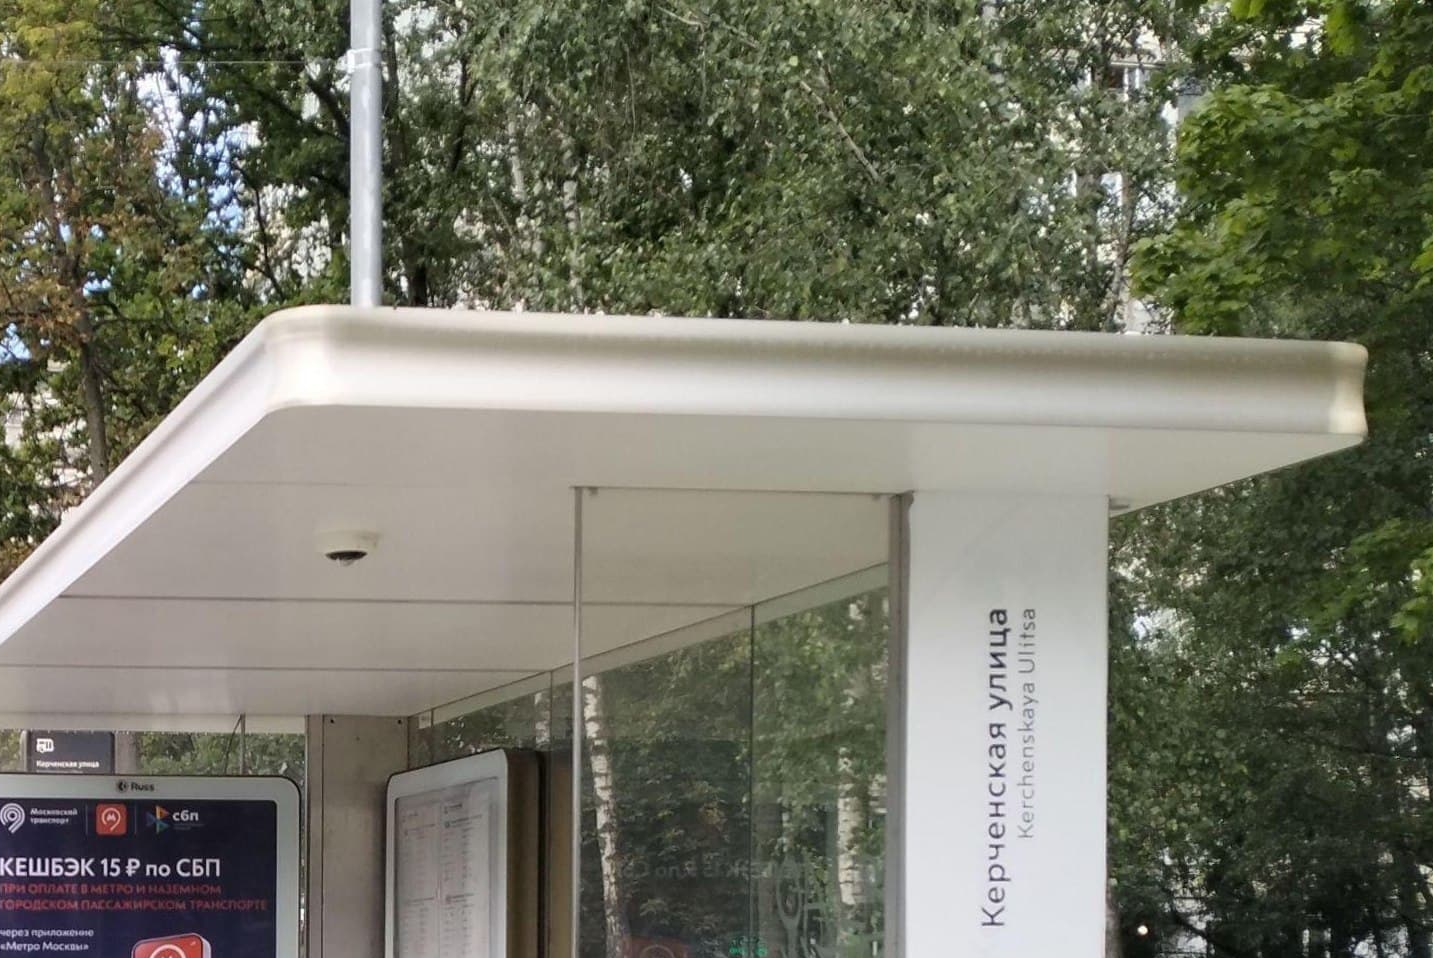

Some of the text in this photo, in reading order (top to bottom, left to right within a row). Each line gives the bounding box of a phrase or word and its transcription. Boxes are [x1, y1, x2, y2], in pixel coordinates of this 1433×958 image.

[1017, 607, 1039, 839] Kerchenskaya Ulitsa
[981, 608, 1014, 927] Керченская улица
[30, 807, 78, 816] Московский
[30, 817, 69, 825] транспорт
[0, 857, 95, 877] КЕШБЭК
[100, 857, 121, 877] 15
[145, 862, 171, 877] по
[175, 858, 221, 877] СБП
[0, 883, 27, 894] ПРИ
[28, 883, 79, 894] ОПЛАТЕ
[80, 884, 88, 894] В
[90, 884, 134, 894] МЕТРО
[148, 884, 222, 894] НАЗЕМНОМ
[0, 899, 267, 910] ГОРОДСКОМ ПАССАЖИРСКОМ ТРАНСПОРТЕ
[0, 929, 94, 939] через приложение
[0, 942, 89, 952] «Метро Москвы»
